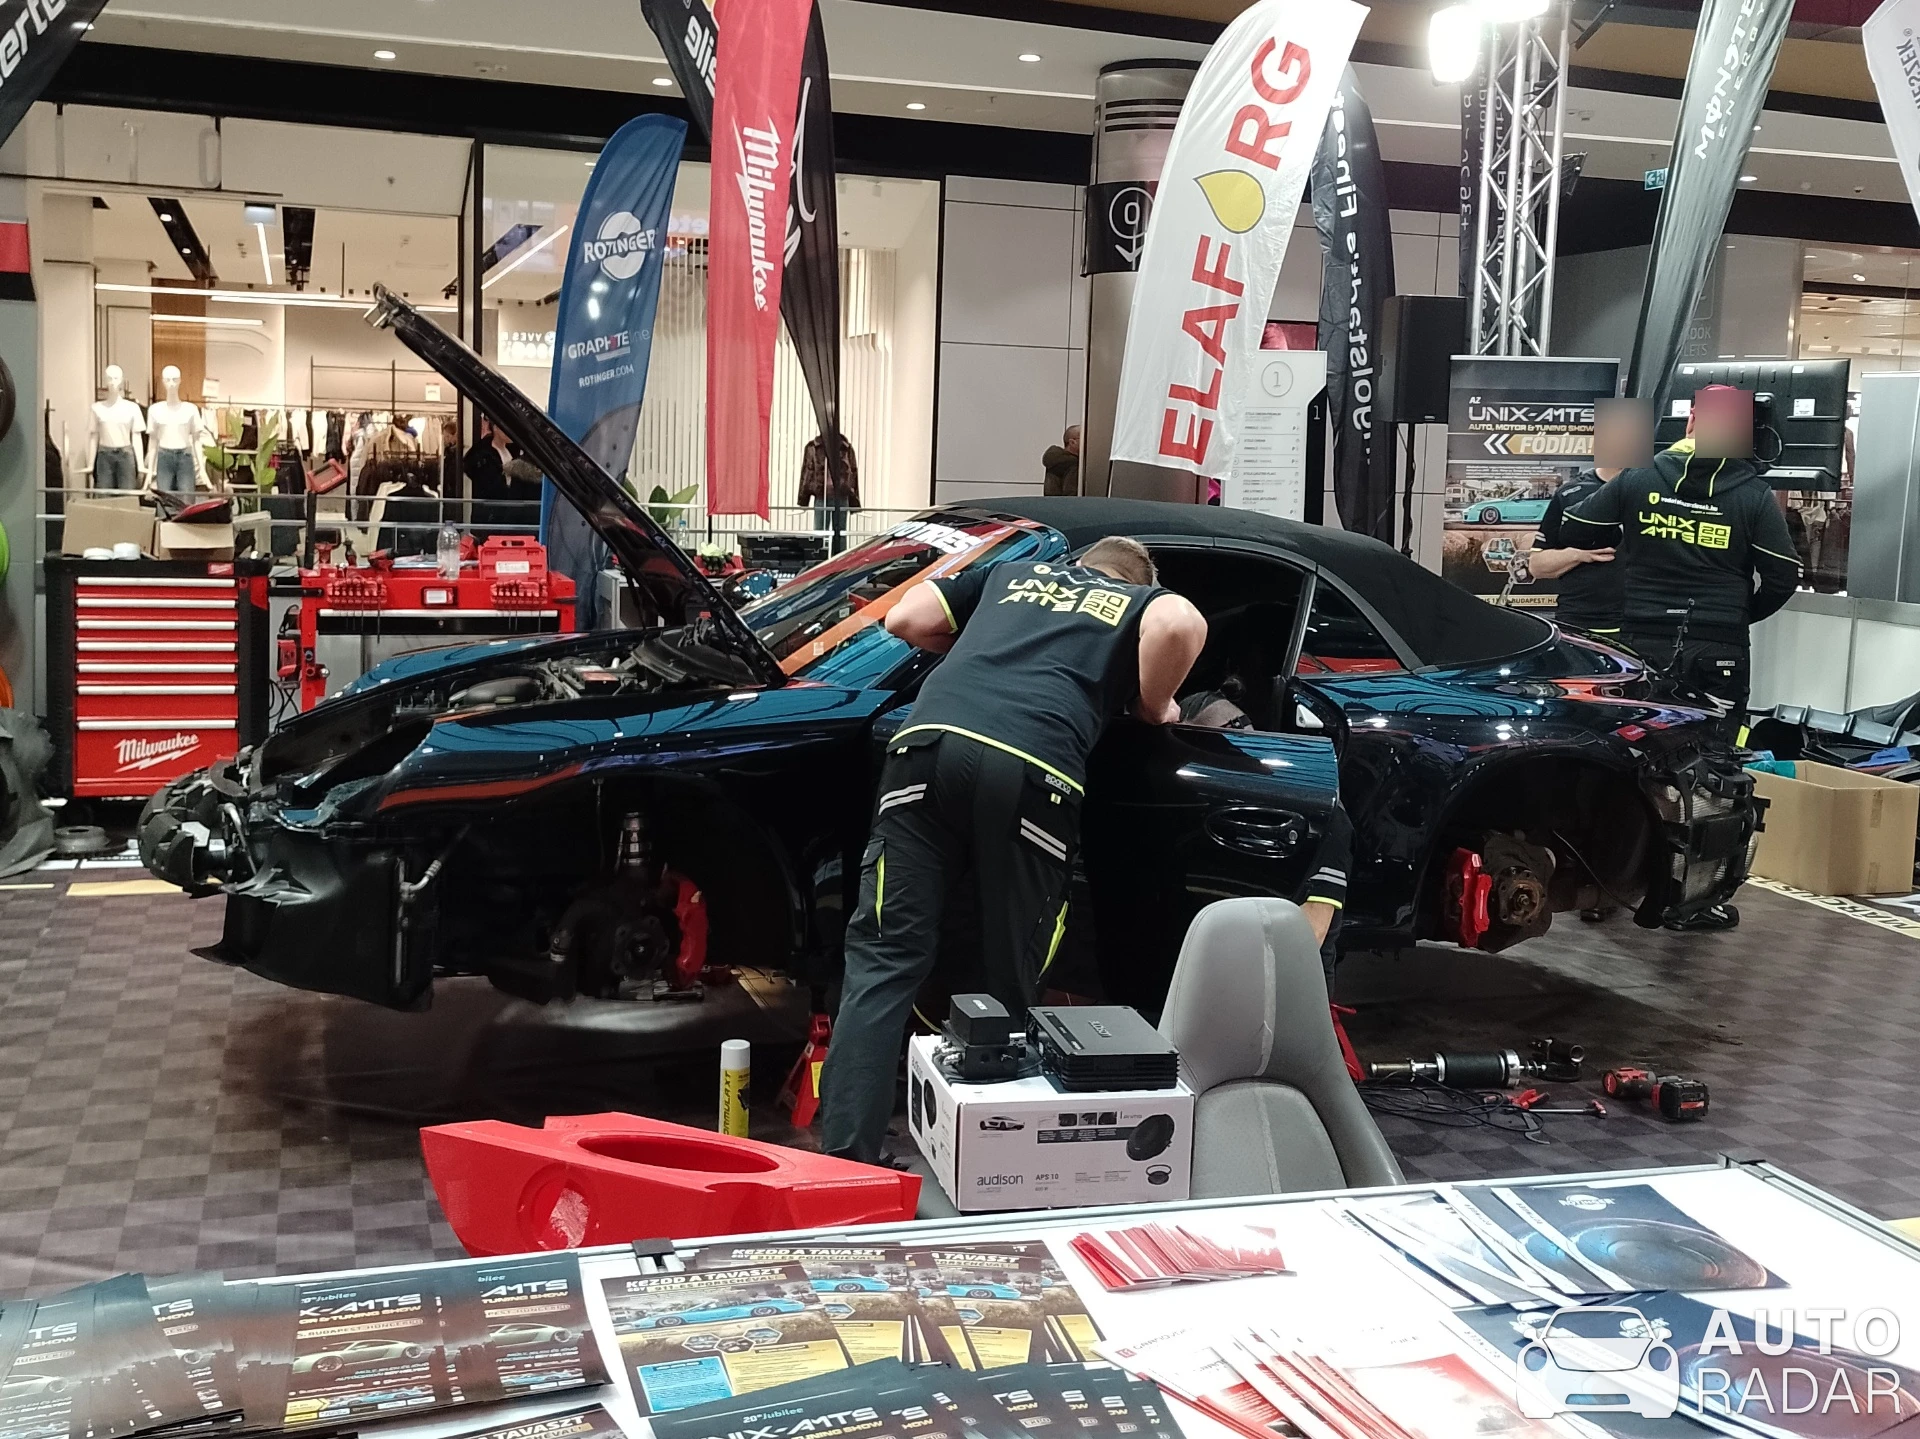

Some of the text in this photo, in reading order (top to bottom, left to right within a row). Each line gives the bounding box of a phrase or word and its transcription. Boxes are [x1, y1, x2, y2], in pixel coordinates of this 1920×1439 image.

[742, 115, 781, 312] Milwaukee
[583, 229, 656, 263] ROTINGER
[567, 330, 630, 360] GRAPHITE
[578, 364, 635, 388] ROTINGER.COM
[1469, 396, 1481, 404] AZ
[1468, 406, 1594, 423] UNIX-AMTS
[1468, 424, 1495, 432] AUTO,
[1498, 424, 1526, 432] MOTOR
[1519, 431, 1593, 454] FŐDÍJA!
[1639, 511, 1696, 532] UNIX
[1640, 525, 1695, 544] AMTS
[1007, 578, 1086, 599] UNIX
[997, 590, 1078, 612] AMTS
[114, 732, 202, 765] Milwaukee
[723, 1088, 732, 1135] ORMULA
[976, 1173, 1024, 1187] audison
[943, 1253, 1020, 1264] TAVASZT
[626, 1276, 687, 1288] KEZDD
[703, 1267, 783, 1280] TAVASZT
[299, 1293, 421, 1317] X-AMTS
[530, 1291, 568, 1300] SHOW
[381, 1305, 421, 1315] SHOW
[32, 1336, 77, 1348] SHOW
[842, 1420, 883, 1434] SHOW
